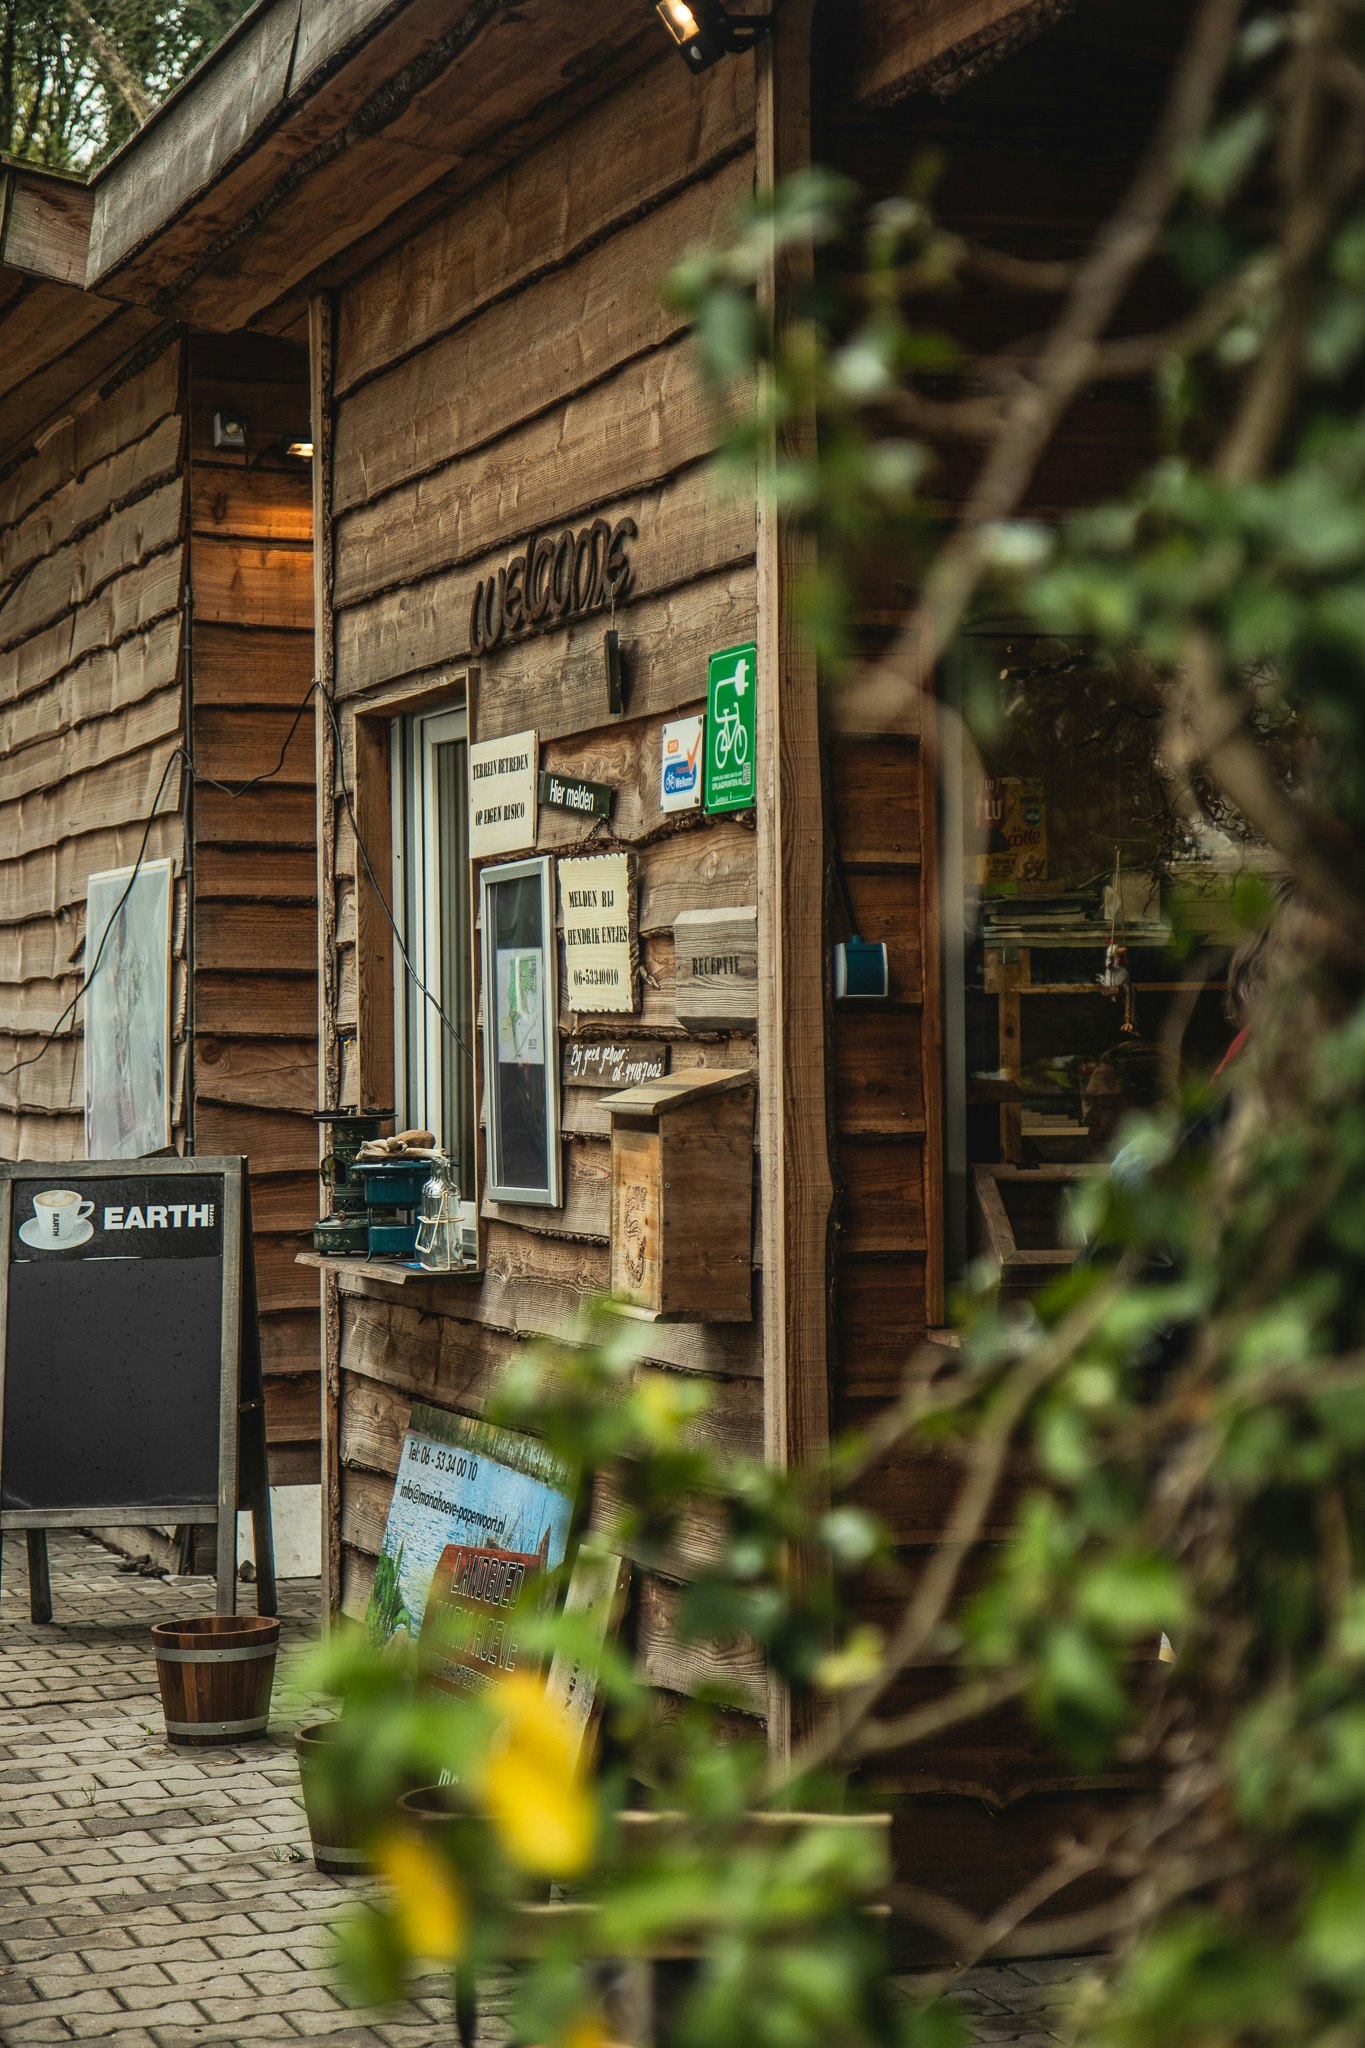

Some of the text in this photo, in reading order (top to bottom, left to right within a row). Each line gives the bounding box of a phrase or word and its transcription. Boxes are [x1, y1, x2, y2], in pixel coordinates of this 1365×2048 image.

[469, 517, 637, 656] welcome
[473, 753, 528, 780] TERREIN BETREDEN
[549, 778, 594, 811] Hier melden
[475, 802, 525, 827] OP EIGEN RISICO
[985, 799, 1002, 820] LU
[568, 890, 614, 908] MELDEN BIJ
[567, 925, 628, 945] HENDRIK ENTJES
[574, 968, 619, 986] 06-53340010
[692, 955, 740, 976] RECEPTIE
[570, 1044, 583, 1077] Bij
[581, 1046, 600, 1076] geen
[104, 1204, 209, 1230] EARTH
[408, 1441, 420, 1462] Tel:
[421, 1446, 431, 1465] 06
[435, 1450, 446, 1470] 53
[446, 1454, 457, 1474] 34
[457, 1457, 467, 1478] 00
[468, 1461, 478, 1481] 10
[400, 1479, 507, 1535] info@mariahoeve-papenvoort.nl
[451, 1552, 526, 1610] LANDGOED
